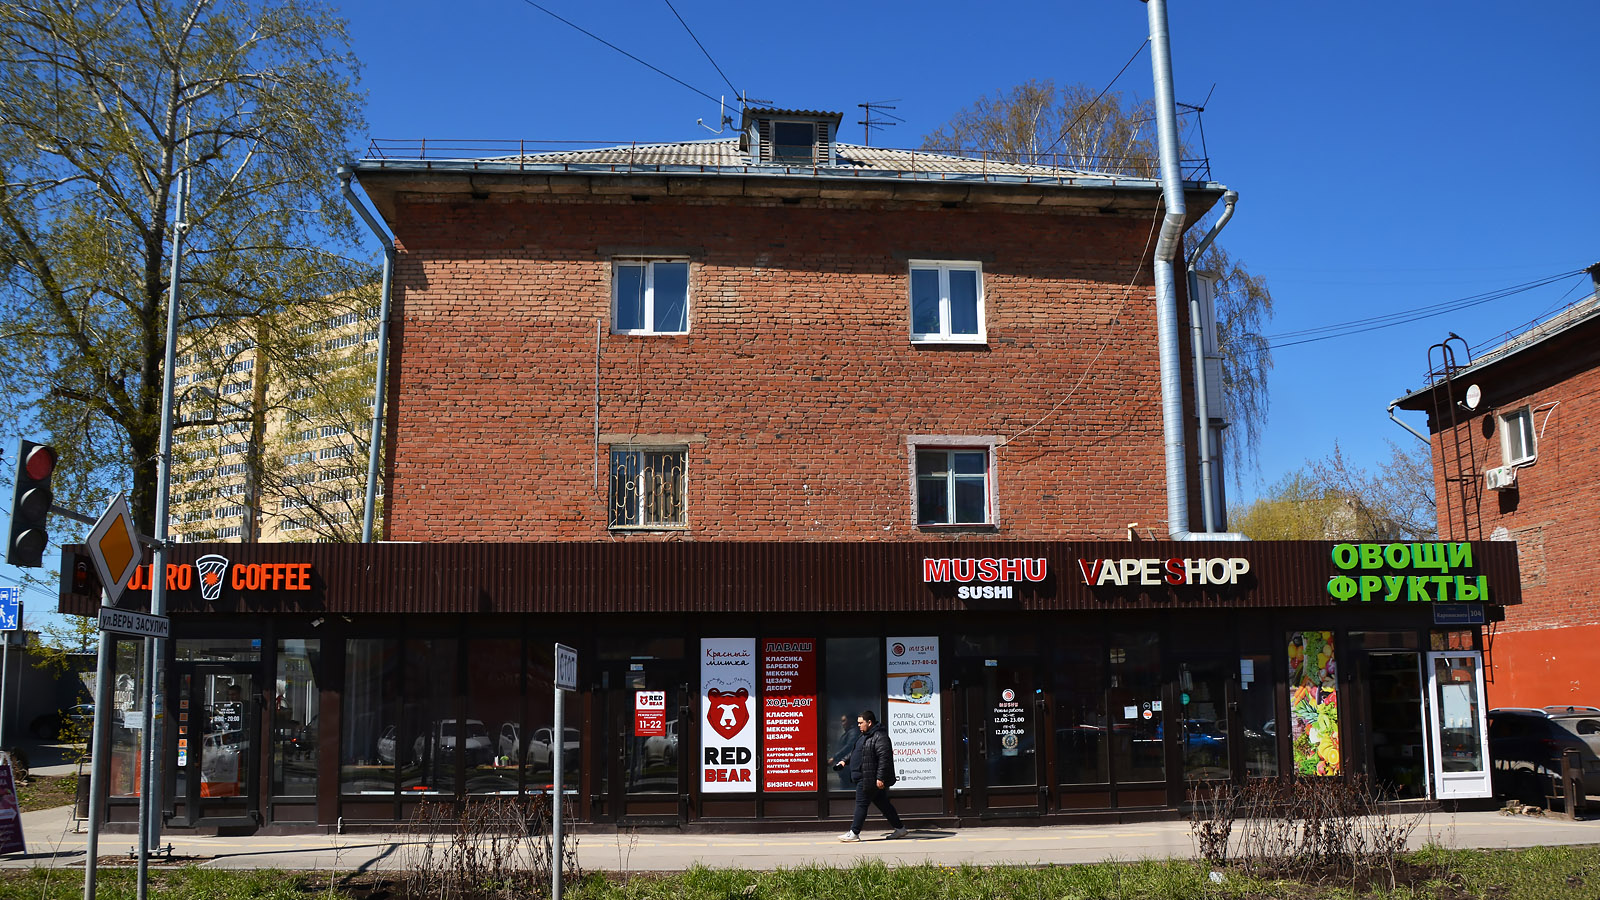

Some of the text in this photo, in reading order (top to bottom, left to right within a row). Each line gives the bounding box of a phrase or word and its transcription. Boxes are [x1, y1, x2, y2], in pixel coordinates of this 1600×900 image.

[1332, 542, 1472, 573] ОВОЩИ
[232, 564, 312, 590] COFFEE
[924, 558, 1047, 582] MUSHU
[958, 586, 1013, 599] SUSHI
[1327, 575, 1489, 602] ФРУКТЫ
[136, 617, 168, 634] ЗАСУЛИЧ
[706, 648, 750, 660] Красный
[766, 642, 812, 652] ЛАВАШ
[560, 653, 574, 682] СТОП
[766, 698, 813, 707] ХОД-ДОГ
[640, 720, 661, 728] 11-22
[704, 747, 752, 765] RED
[705, 769, 751, 782] BEAR
